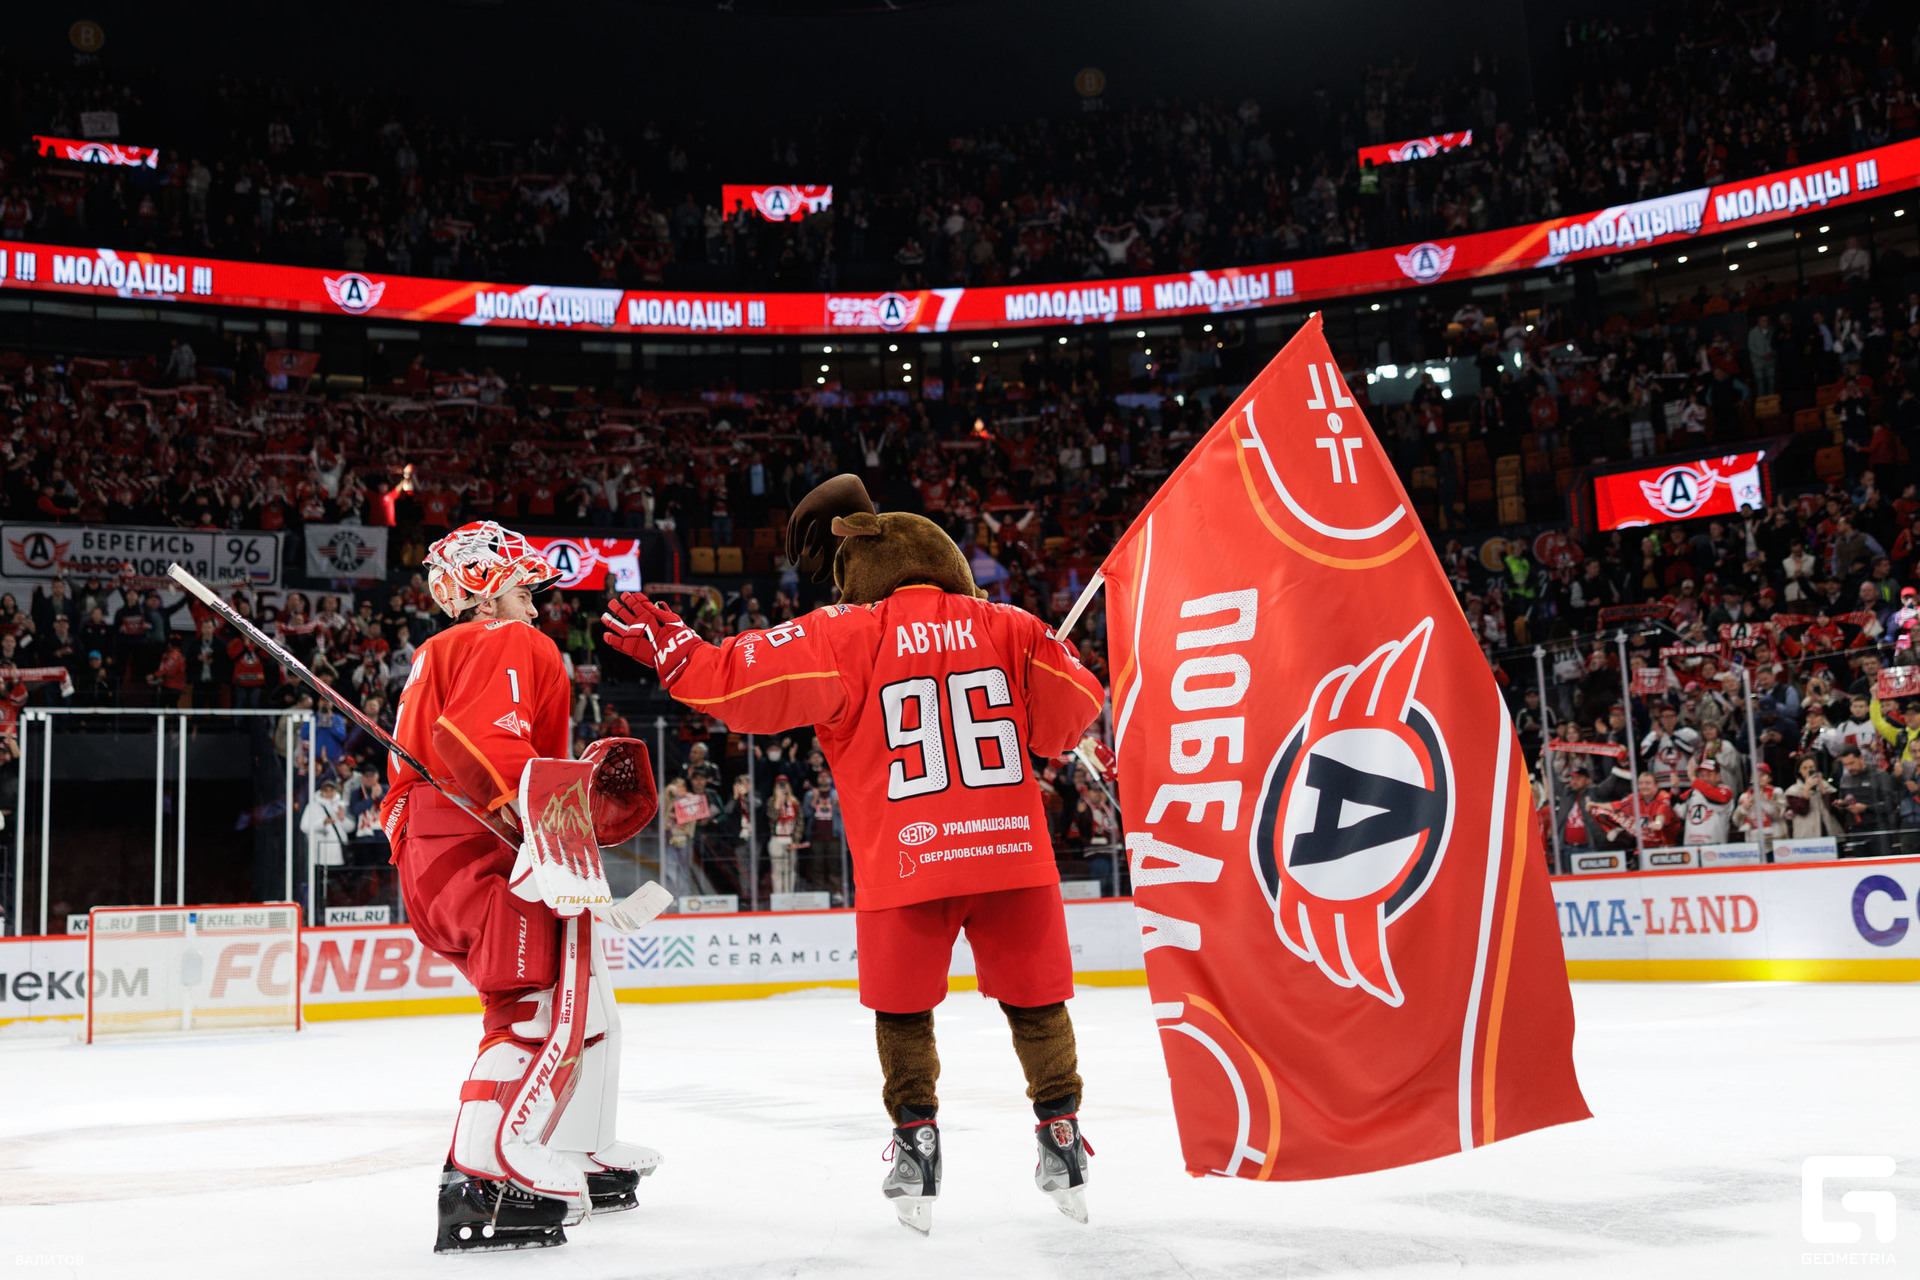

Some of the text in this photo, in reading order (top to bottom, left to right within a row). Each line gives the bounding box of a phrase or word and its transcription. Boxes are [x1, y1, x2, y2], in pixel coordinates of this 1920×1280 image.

[1548, 207, 1673, 258] МОЛОДЦЫ
[1714, 166, 1850, 223] МОЛОДЦЫ
[53, 254, 185, 297] МОЛОДЦЫ
[475, 291, 591, 327] МОЛОДЦЫ
[628, 298, 742, 331] МОЛОДЦЫ
[1005, 285, 1118, 321] МОЛОДЦЫ
[1153, 272, 1270, 311] МОЛОДЦЫ
[83, 532, 194, 554] БЕРЕГИСЬ
[228, 539, 260, 564] 96
[218, 567, 246, 579] RUS
[896, 618, 978, 658] АВТИК
[506, 669, 520, 703] 1
[880, 666, 1025, 802] 96
[1125, 588, 1258, 953] ПОБЕДА
[942, 815, 1030, 836] УРАЛМАШЗАВОД
[919, 841, 1033, 864] СВЕРДЛОВСКАЯ ОБЛАСТЬ
[555, 895, 613, 904] MIKLIN
[330, 910, 385, 924] KHL.RU
[708, 933, 782, 947] ALMA
[210, 938, 456, 998] FONBE
[708, 950, 858, 966] CERAMICA
[563, 989, 573, 1024] ULTRA
[511, 1042, 562, 1135] MIKLIN
